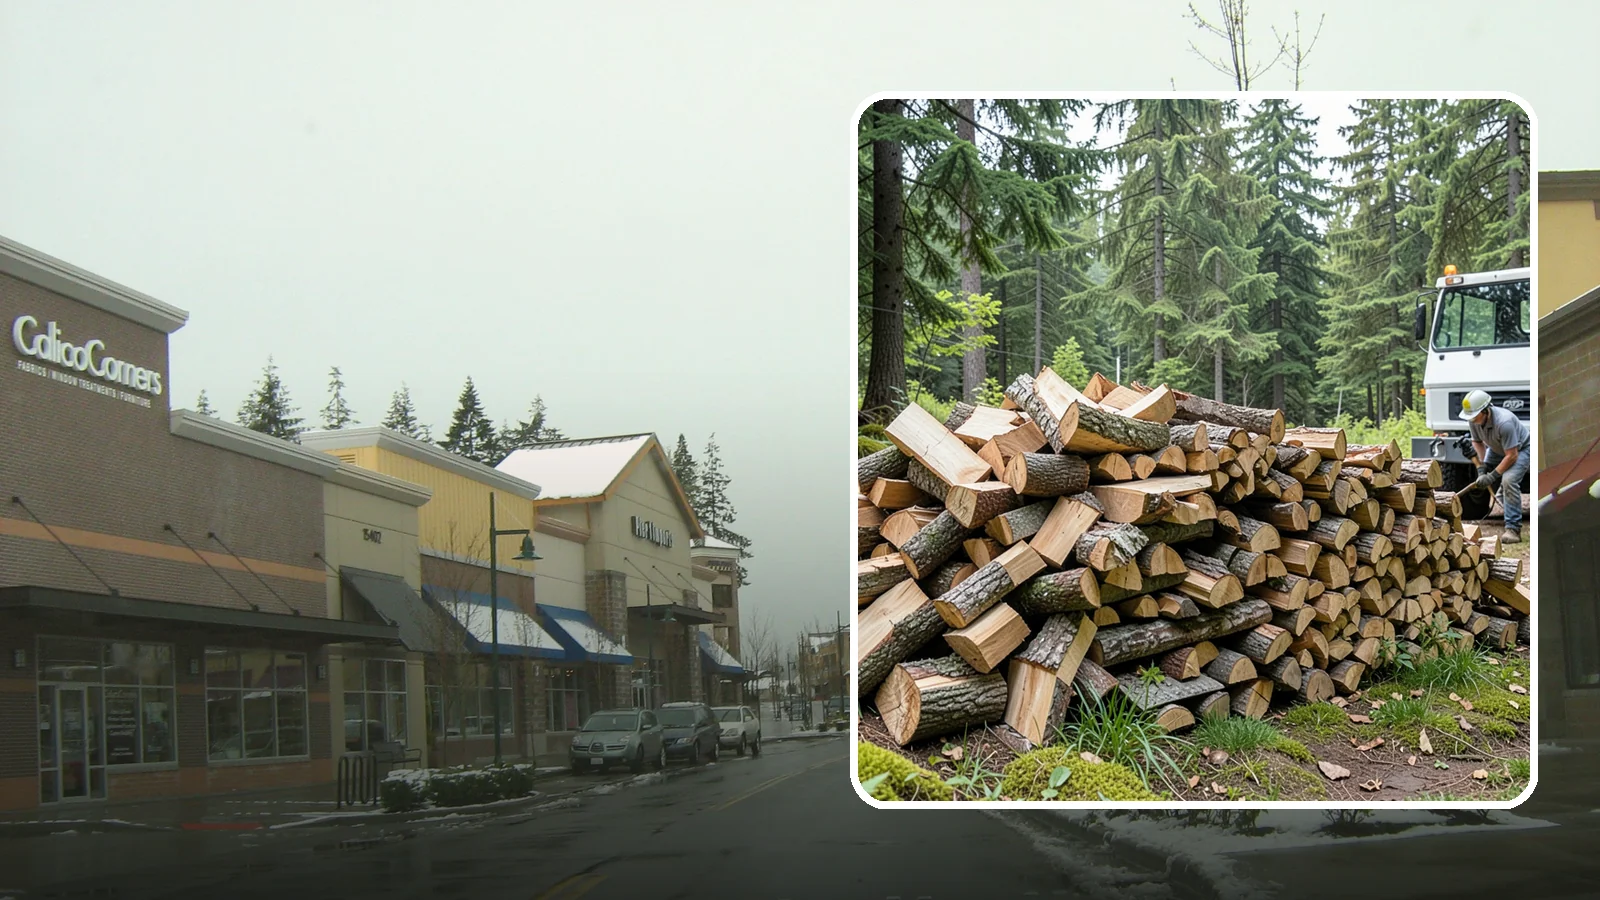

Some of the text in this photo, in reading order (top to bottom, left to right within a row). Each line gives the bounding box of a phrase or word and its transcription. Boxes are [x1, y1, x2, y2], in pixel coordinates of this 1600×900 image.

[17, 360, 46, 377] FABRICS
[51, 371, 78, 387] WINDOW
[79, 378, 116, 399] TREATMENTS
